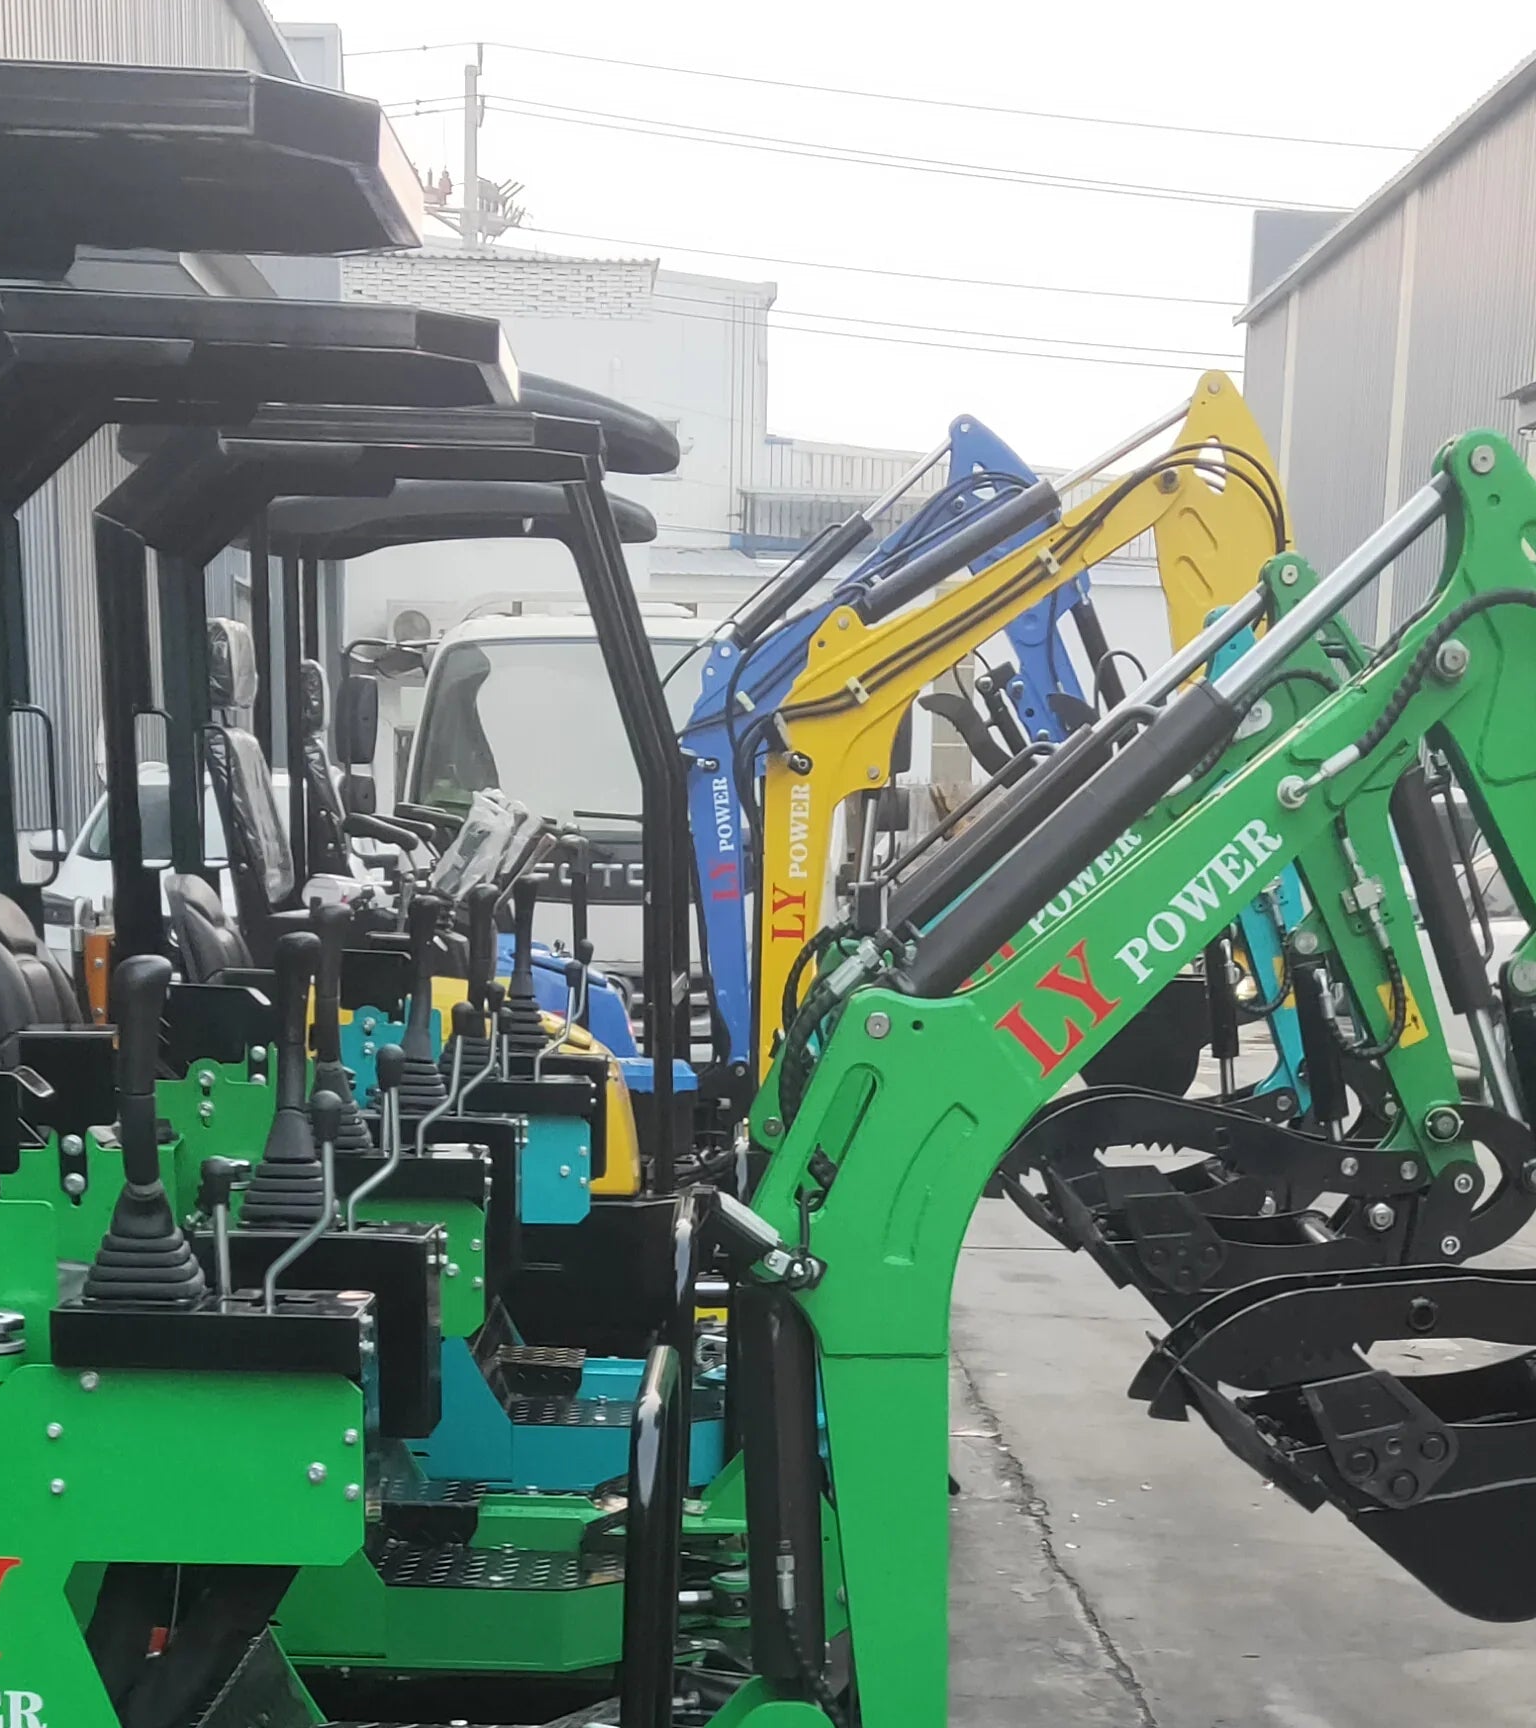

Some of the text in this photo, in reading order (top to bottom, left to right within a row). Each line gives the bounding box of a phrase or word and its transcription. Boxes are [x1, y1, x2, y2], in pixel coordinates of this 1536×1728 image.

[708, 776, 741, 901] LY POWER
[771, 782, 811, 943] LY POWER
[994, 817, 1284, 1079] LY POWER
